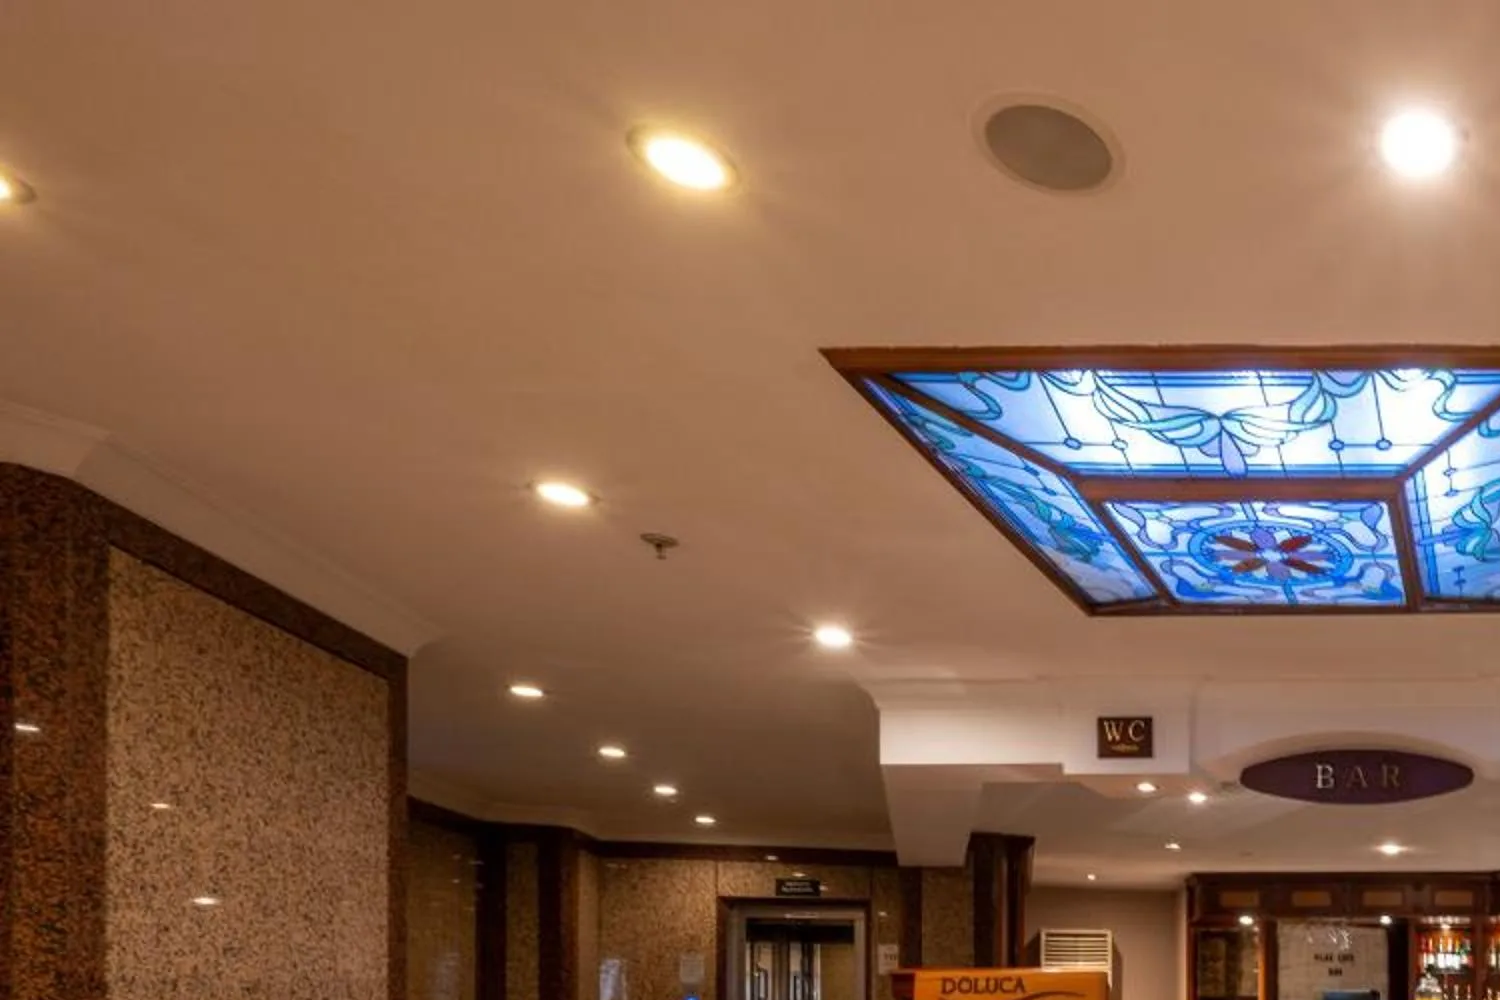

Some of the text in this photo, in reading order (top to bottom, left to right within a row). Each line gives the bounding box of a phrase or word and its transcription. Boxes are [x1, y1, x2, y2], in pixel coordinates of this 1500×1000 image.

[1103, 719, 1145, 742] WC
[1315, 763, 1401, 790] BAR
[940, 975, 1027, 996] DOLUCA
